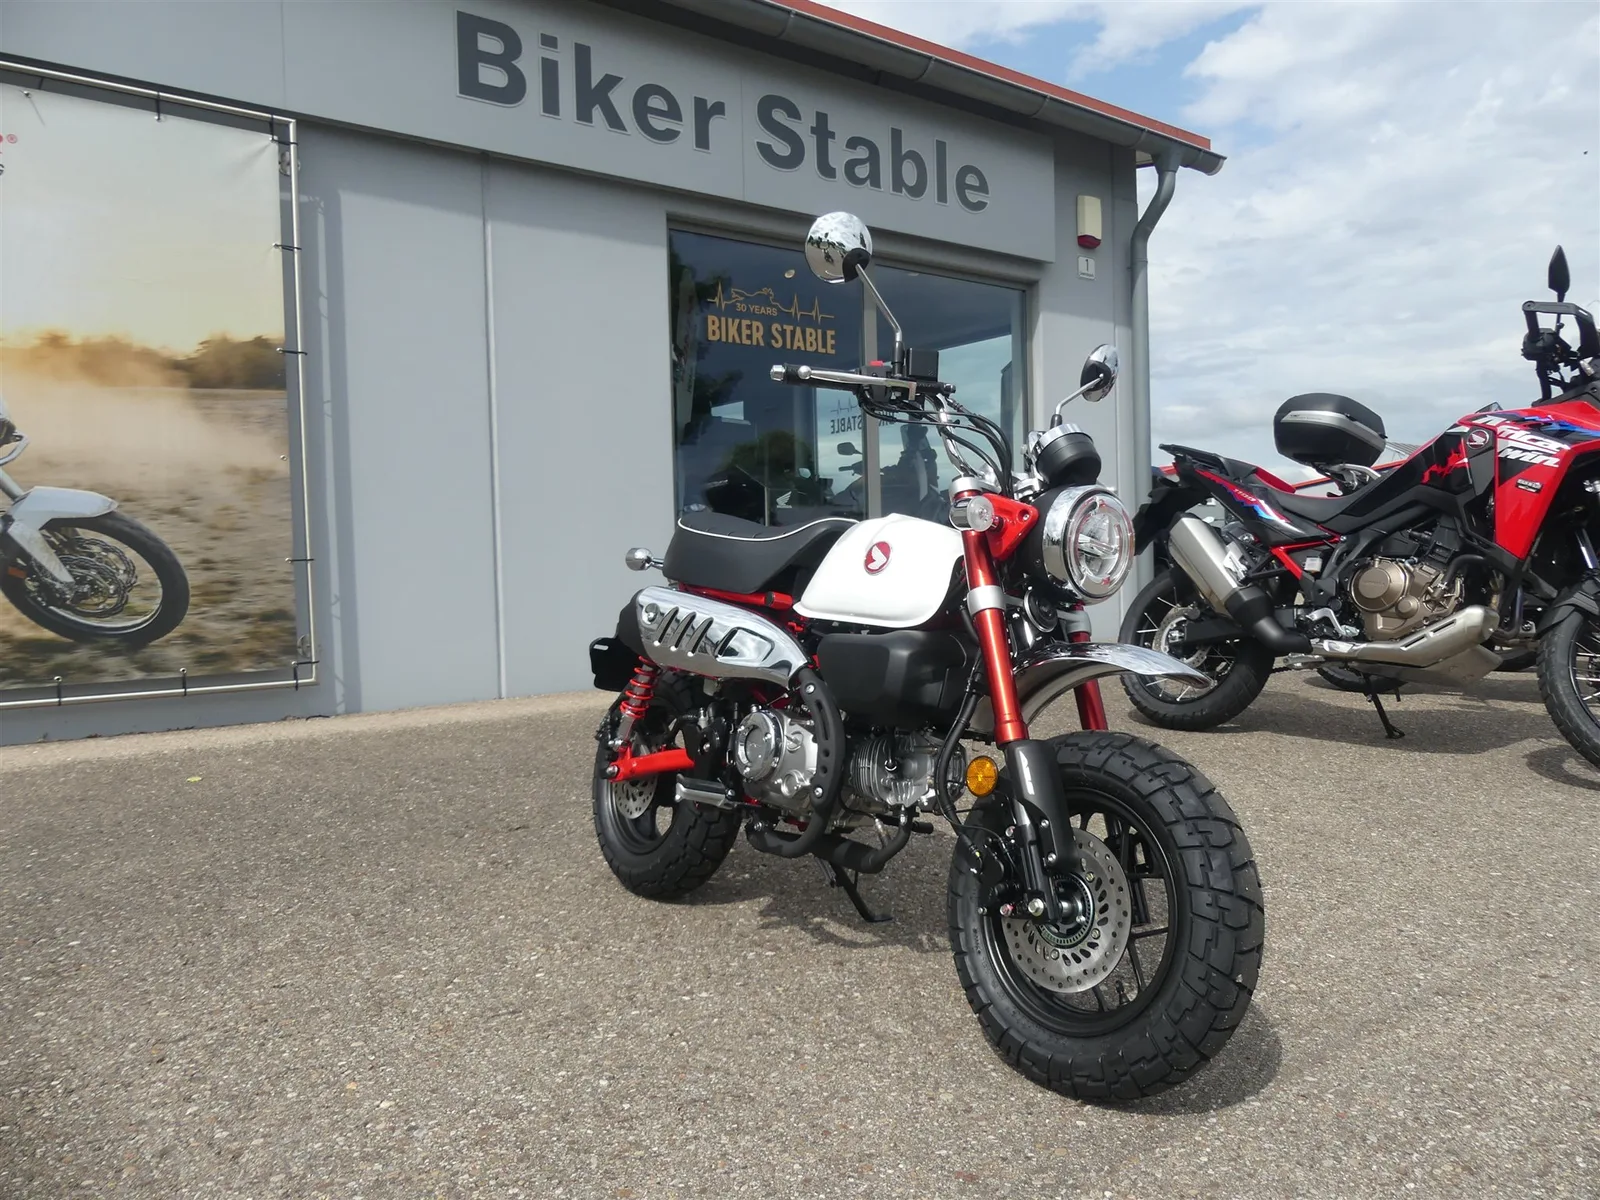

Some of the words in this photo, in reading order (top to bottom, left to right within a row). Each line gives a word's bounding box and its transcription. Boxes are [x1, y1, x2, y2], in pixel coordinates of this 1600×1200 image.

[456, 9, 726, 152] Biker
[755, 93, 990, 213] Stable
[736, 302, 747, 313] 30
[749, 304, 778, 317] YEARS
[707, 314, 765, 347] BIKER
[771, 322, 836, 355] STABLE
